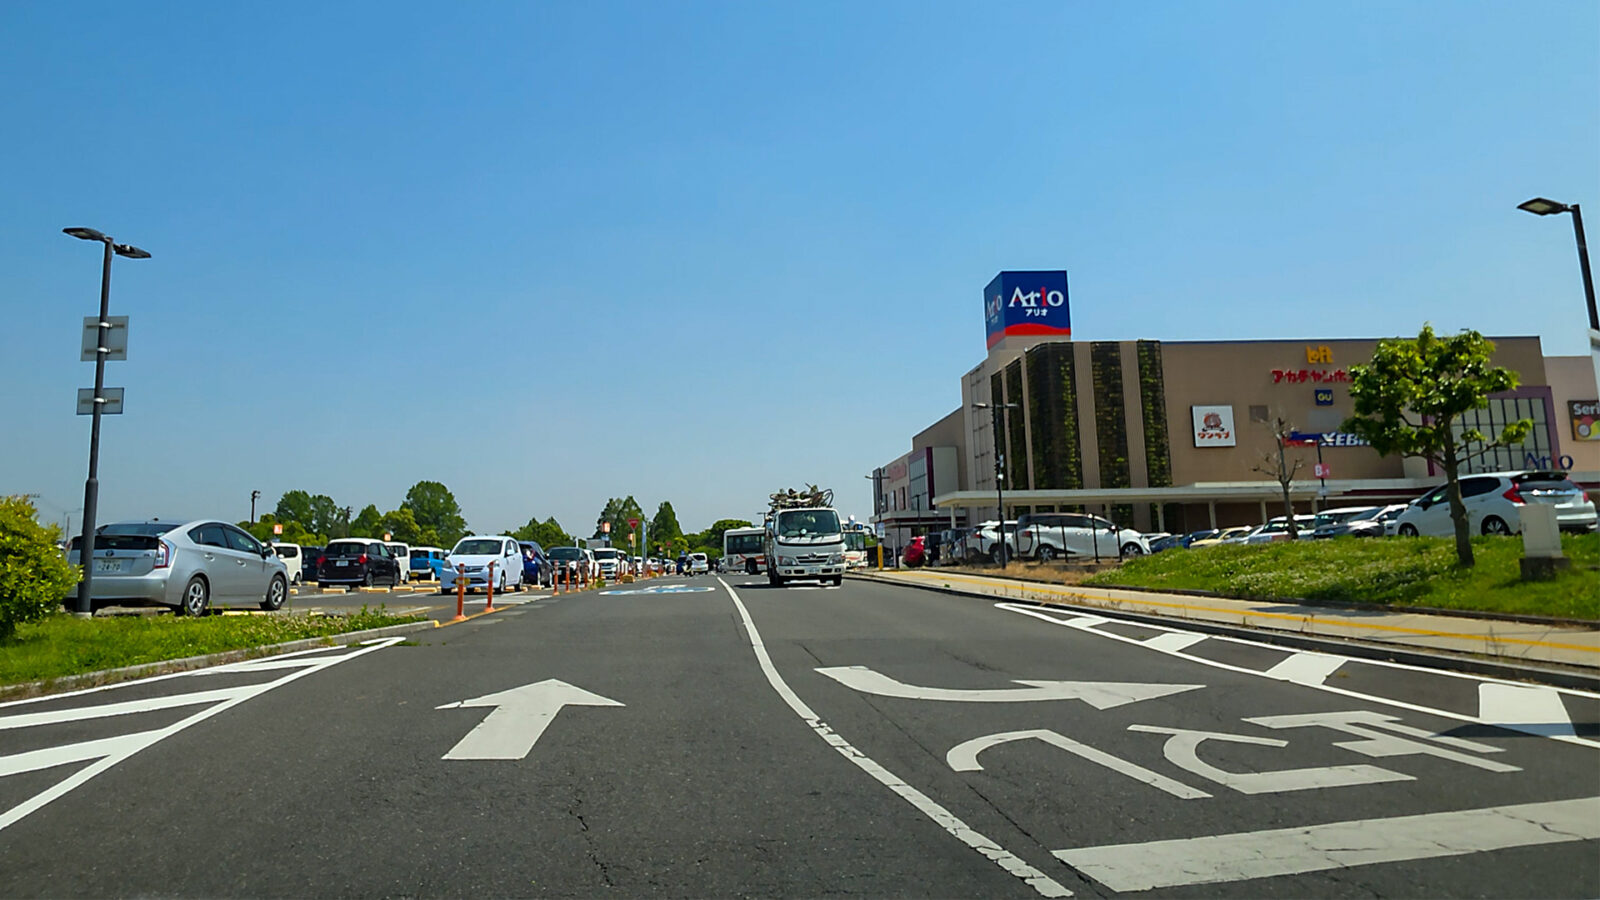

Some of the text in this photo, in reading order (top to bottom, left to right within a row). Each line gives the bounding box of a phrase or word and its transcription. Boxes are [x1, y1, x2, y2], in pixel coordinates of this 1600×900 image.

[1008, 286, 1064, 307] Ario
[1025, 308, 1048, 317] アリオ
[1317, 392, 1332, 401] GU
